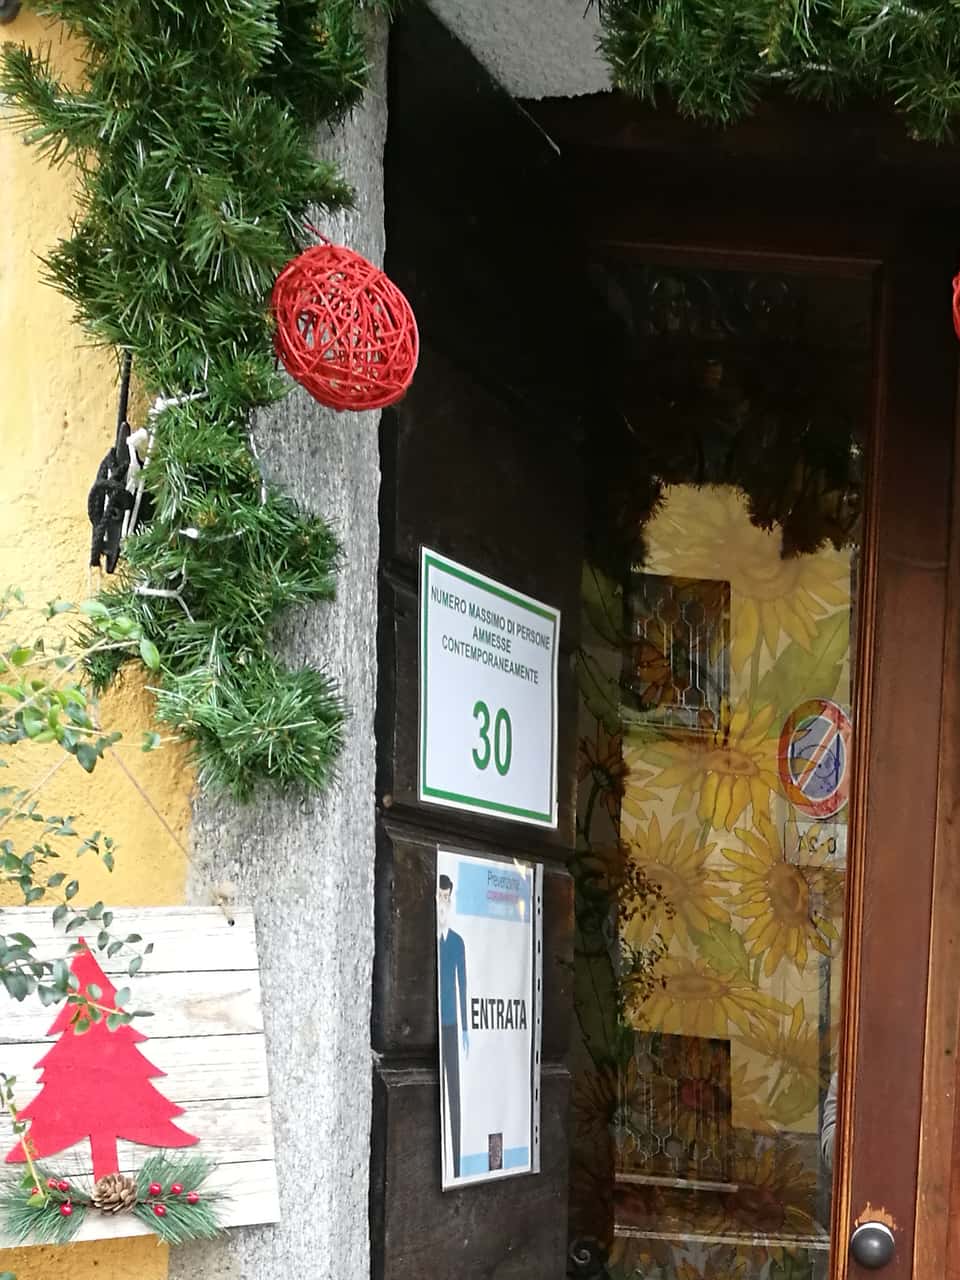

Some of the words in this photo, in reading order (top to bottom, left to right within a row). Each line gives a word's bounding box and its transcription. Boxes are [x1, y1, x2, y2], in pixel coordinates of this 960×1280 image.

[430, 585, 467, 615] NUMERO
[468, 601, 506, 631] MASSIMO
[507, 621, 516, 636] DI
[516, 624, 550, 650] PERSONE
[472, 625, 512, 653] AMMESSE
[441, 634, 539, 685] CONTEMPORANEAMENTE
[472, 700, 512, 776] 30
[471, 998, 528, 1031] ENTRATA
